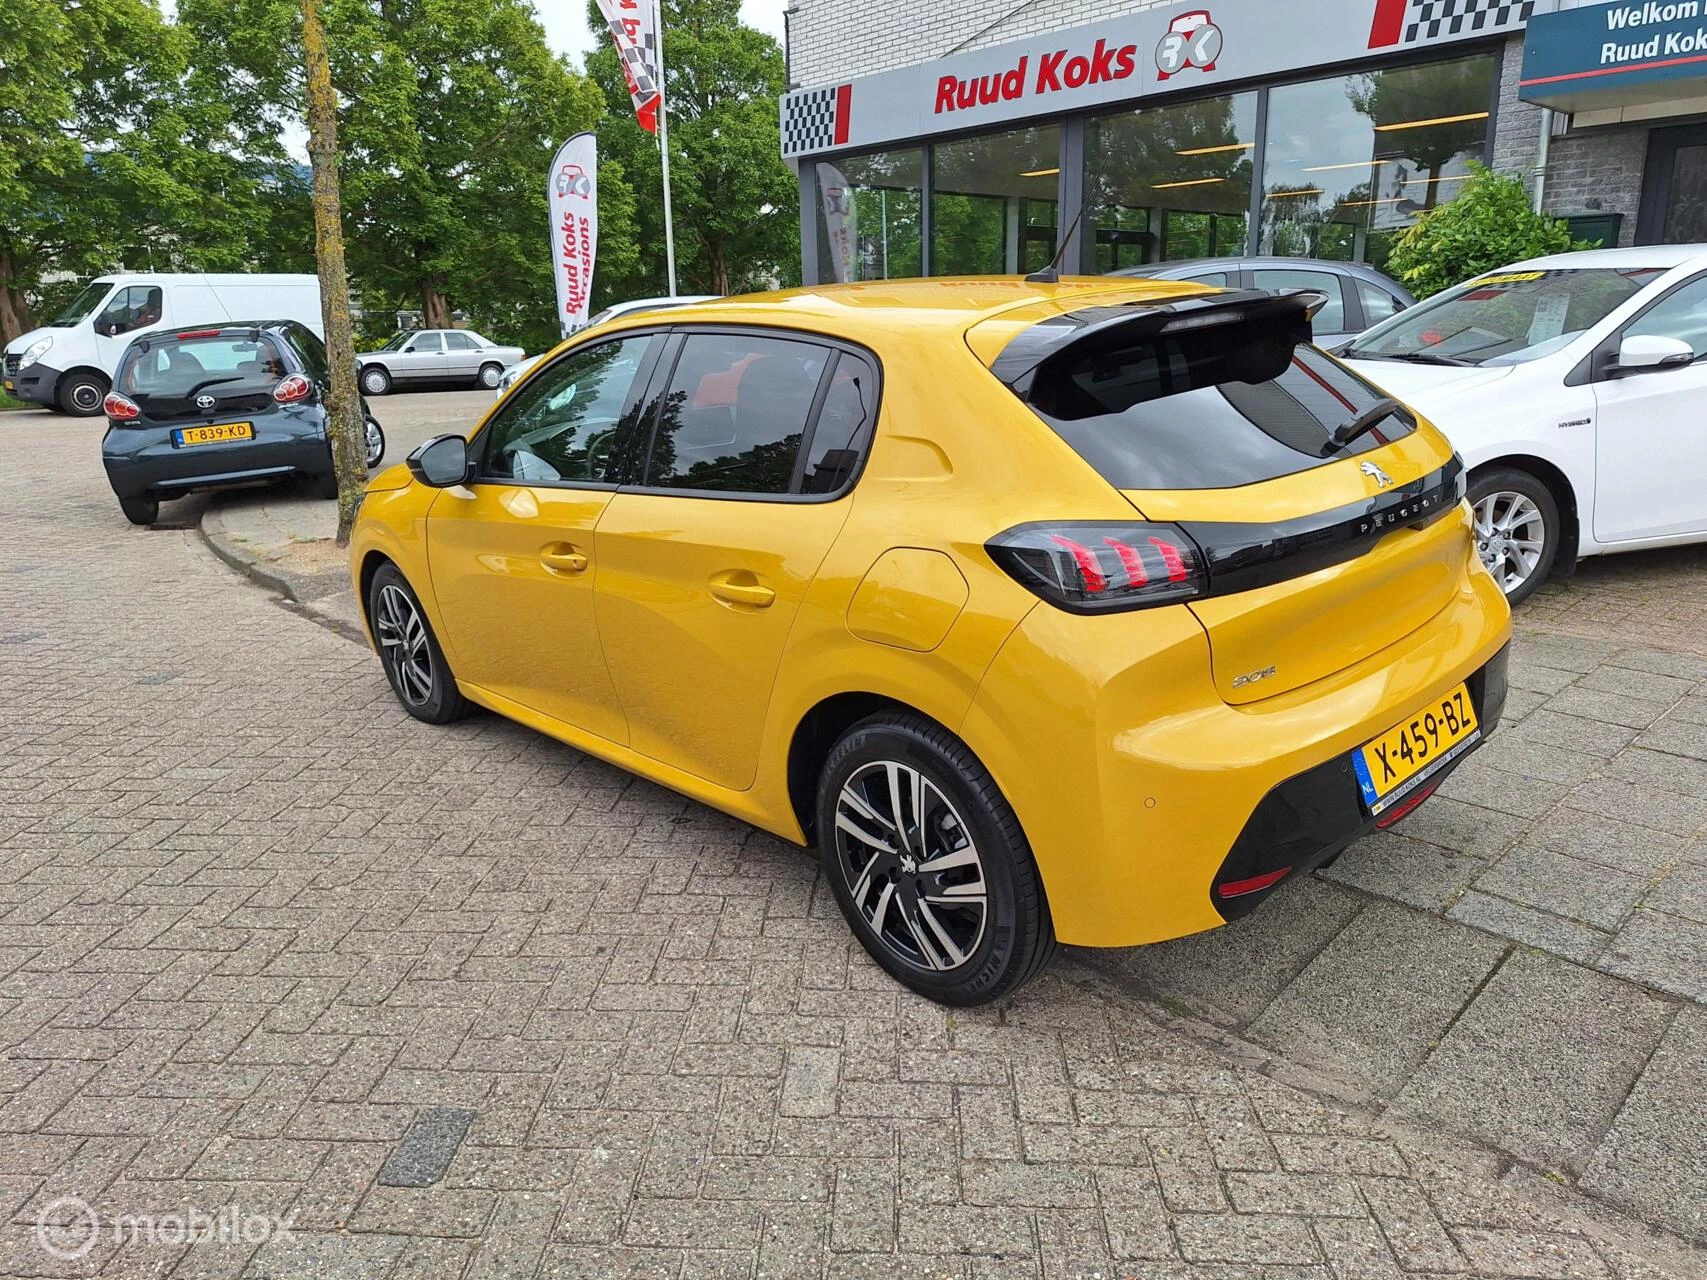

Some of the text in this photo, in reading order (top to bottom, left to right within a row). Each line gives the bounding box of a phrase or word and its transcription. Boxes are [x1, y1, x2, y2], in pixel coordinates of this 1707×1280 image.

[1607, 1, 1699, 30] Welkom
[1600, 34, 1660, 64] Ruud
[934, 55, 1029, 115] Ruud
[1035, 38, 1138, 95] Koks
[561, 211, 580, 315] Ruud Koks
[186, 425, 246, 441] T-839-KD
[1361, 495, 1439, 533] PEUGEOT
[1374, 692, 1471, 784] X-459-BZ
[1362, 781, 1374, 796] NL
